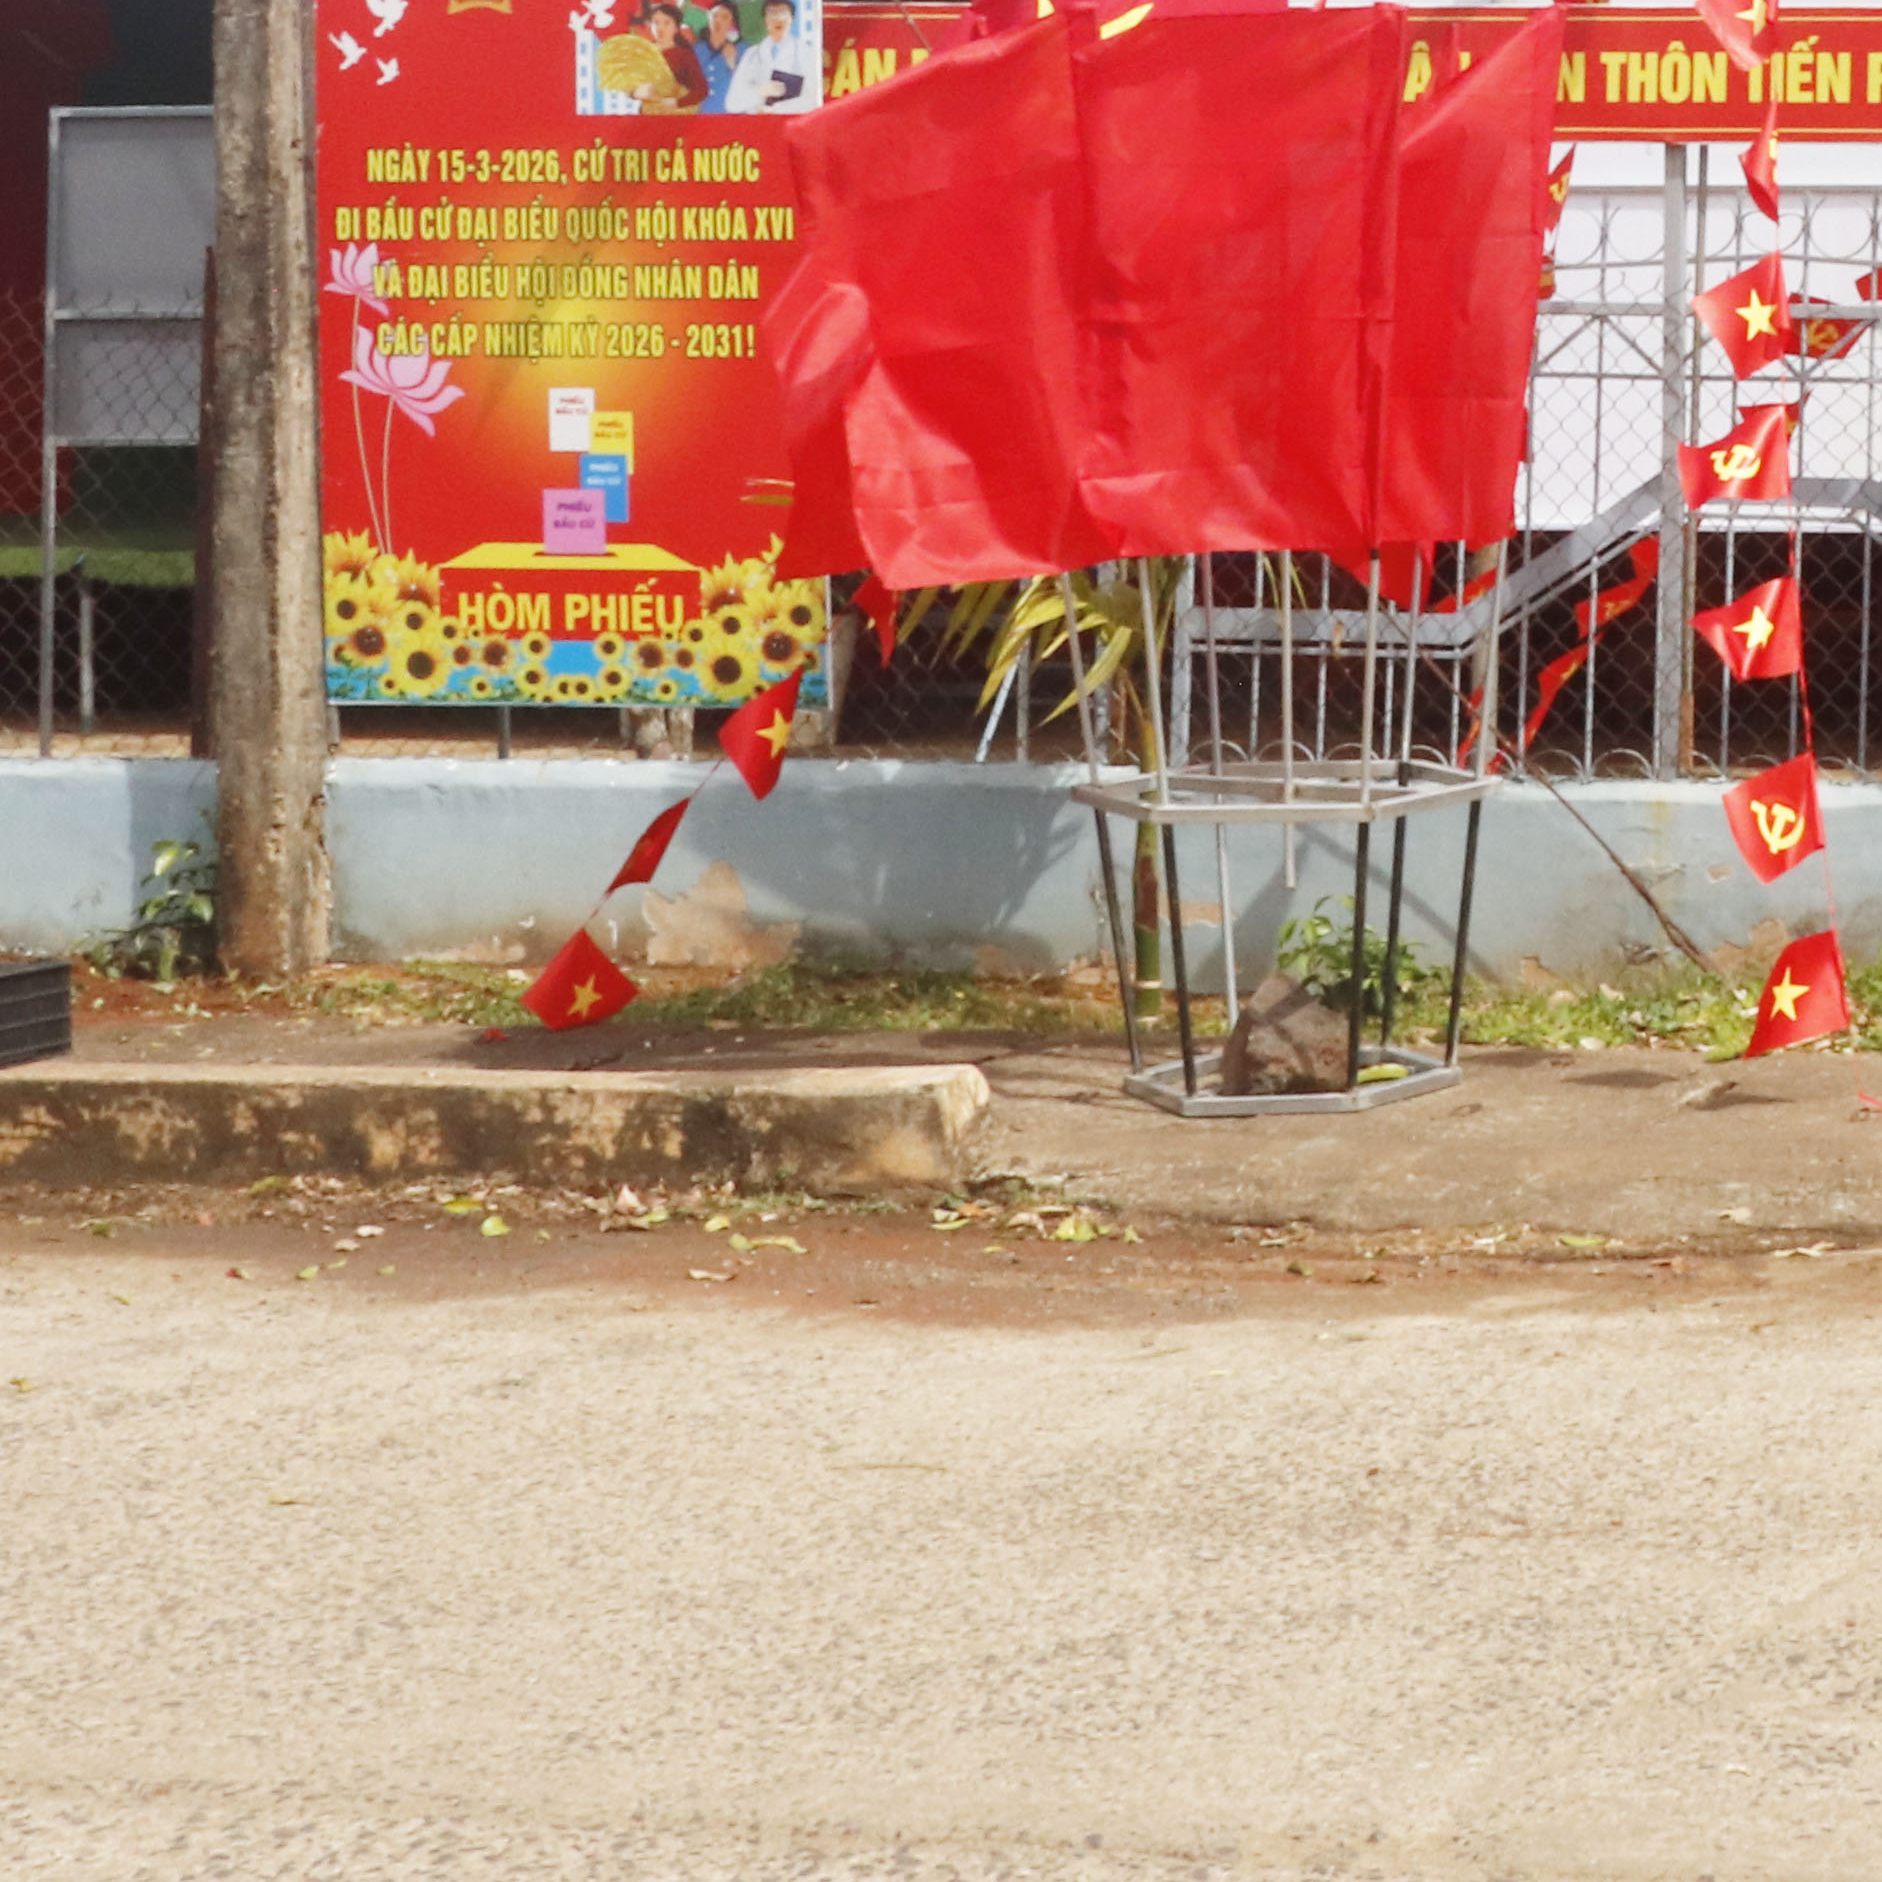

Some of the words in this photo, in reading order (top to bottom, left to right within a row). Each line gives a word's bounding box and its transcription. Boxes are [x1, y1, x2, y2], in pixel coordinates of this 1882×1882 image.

[1600, 40, 1727, 104] THÔN
[367, 142, 431, 183] NGÀY
[437, 148, 568, 186] 15-3-2026,
[573, 136, 609, 183] CỬ
[611, 148, 649, 183] TRI
[655, 136, 688, 183] CẢ
[693, 141, 760, 183] NƯỚC
[336, 206, 361, 241] ĐI
[420, 195, 455, 241] CỬ
[457, 206, 498, 248] ĐẠI
[565, 195, 630, 245] QUỐC
[635, 199, 677, 248] HỘI
[682, 199, 748, 241] KHÓA
[753, 206, 795, 241] XVI
[373, 257, 403, 299] VÀ
[407, 265, 448, 306] ĐẠI
[516, 256, 556, 307] HỘI
[634, 257, 702, 300] NHÂN
[708, 257, 759, 300] DÂN
[377, 315, 426, 357] CÁC
[431, 312, 478, 357] CẤP
[484, 315, 563, 365] NHIỆM
[606, 323, 665, 358] 2026
[686, 323, 755, 358] 2031!
[458, 581, 550, 631] HÒM
[564, 577, 684, 633] PHIẾU
